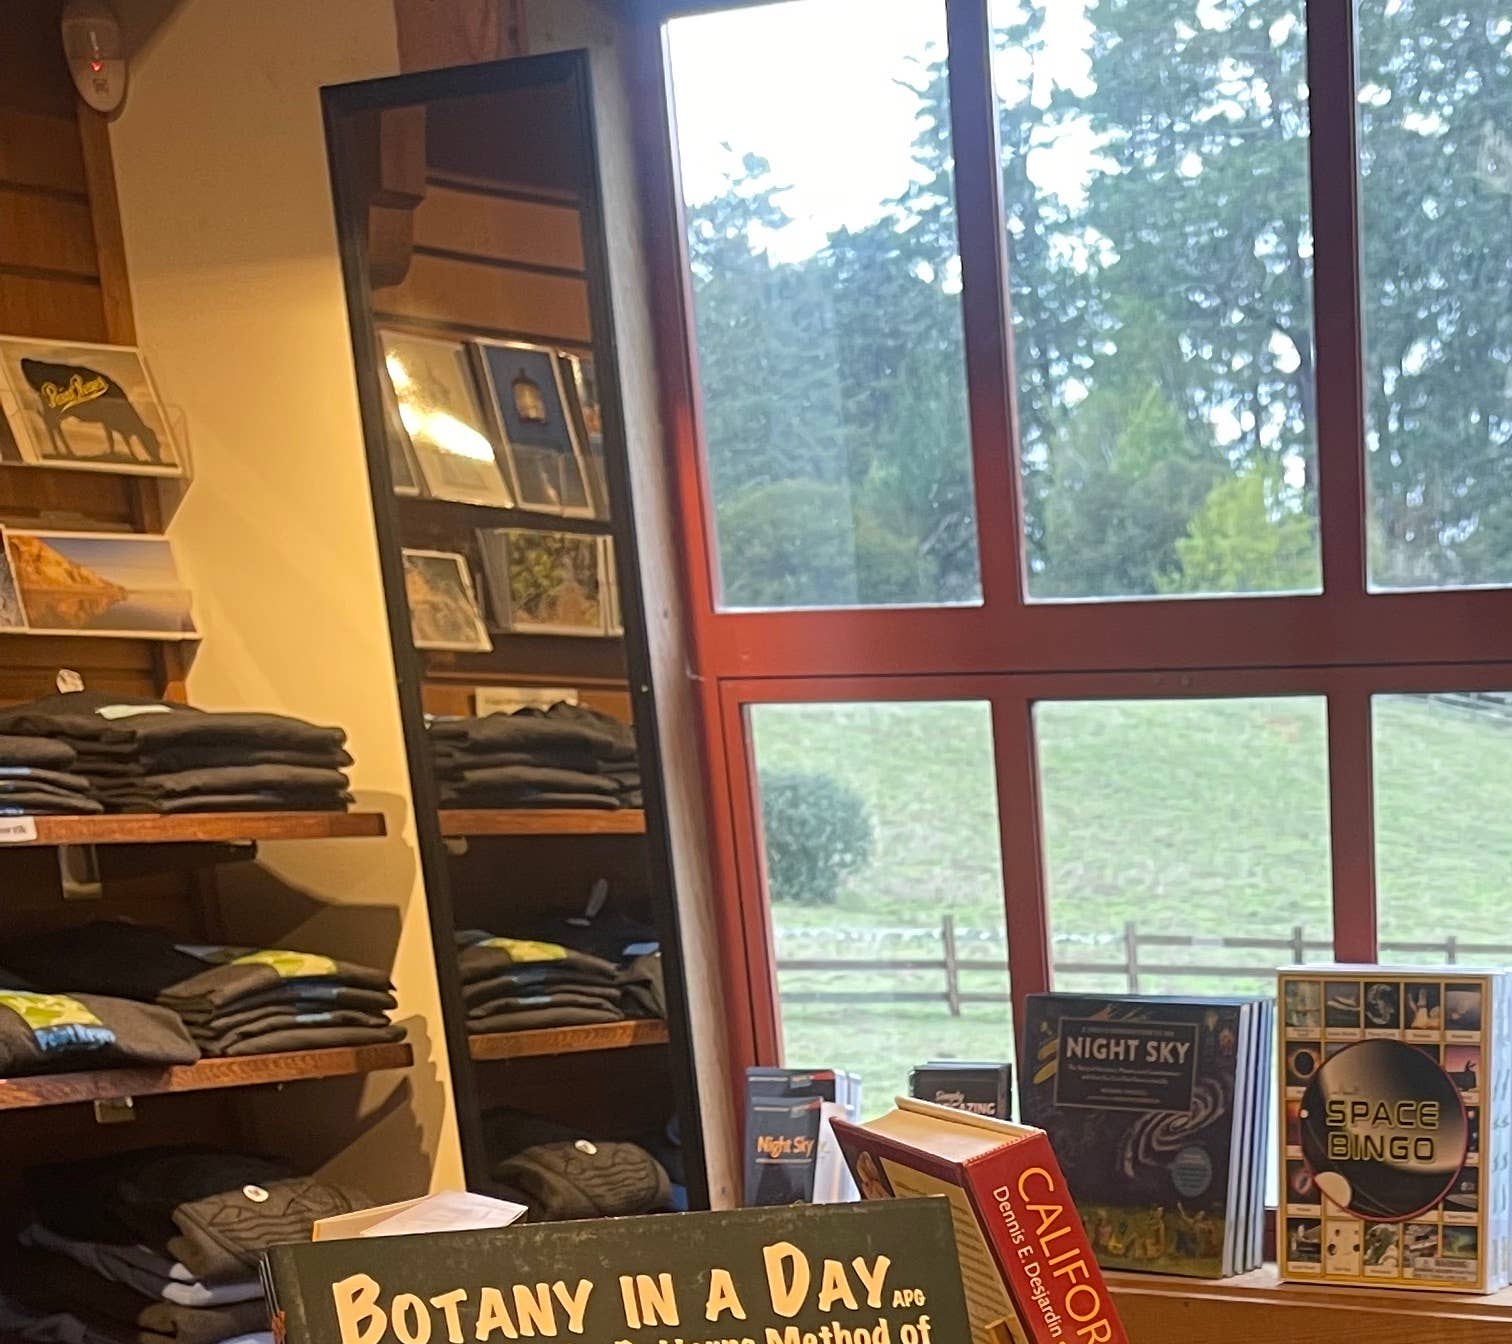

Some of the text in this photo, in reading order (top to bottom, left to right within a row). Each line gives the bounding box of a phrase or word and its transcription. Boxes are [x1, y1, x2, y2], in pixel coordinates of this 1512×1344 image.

[1066, 1036, 1190, 1064] NIGHT SKY
[1325, 1099, 1440, 1130] SPACE
[757, 1136, 814, 1158] Night Sky
[1329, 1132, 1435, 1162] BINGO
[993, 1185, 1026, 1245] Dennis
[1024, 1263, 1064, 1338] Desjardin
[620, 1271, 681, 1332] IN
[705, 1267, 748, 1323] A
[762, 1241, 892, 1310] DAY
[892, 1286, 926, 1311] APG
